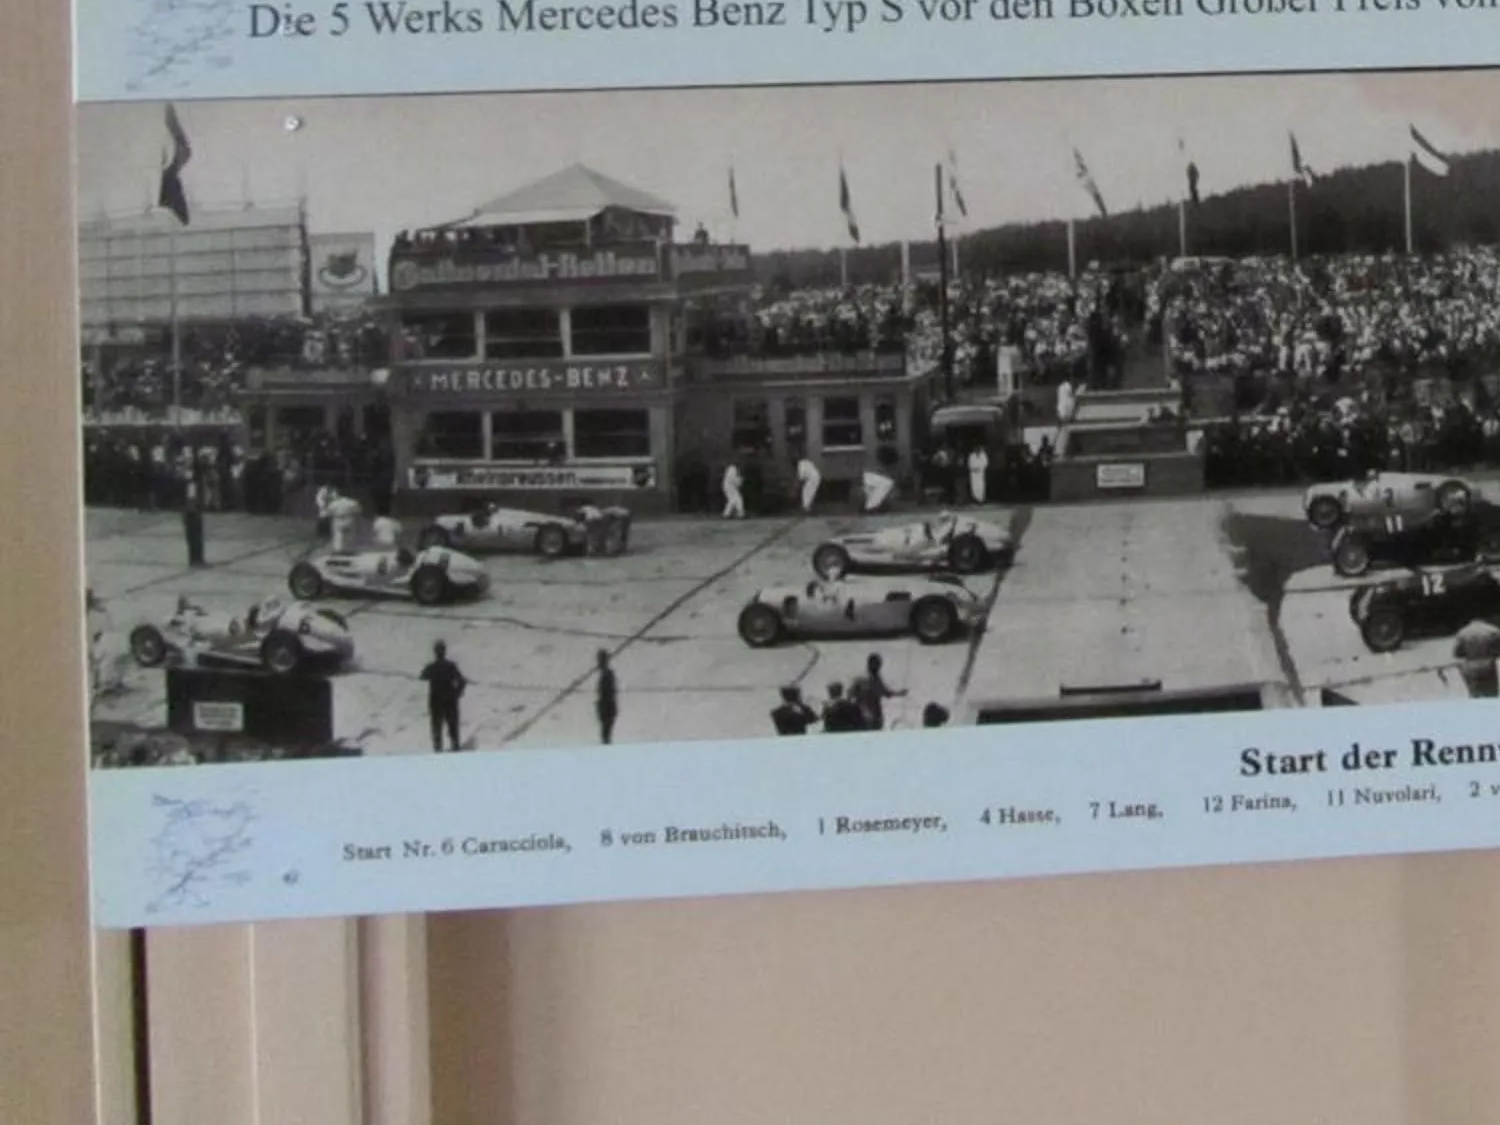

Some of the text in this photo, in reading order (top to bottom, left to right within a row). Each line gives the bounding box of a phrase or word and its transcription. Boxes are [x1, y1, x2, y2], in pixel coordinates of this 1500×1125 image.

[248, 2, 317, 38] Die
[329, 1, 350, 37] 5
[430, 365, 631, 392] MERCEDES-BENZ
[1420, 573, 1447, 597] 12
[1239, 747, 1328, 778] Start
[1340, 741, 1399, 772] der
[342, 842, 393, 862] Start
[402, 839, 437, 859] Nr.
[439, 837, 455, 856] 6
[619, 830, 657, 847] von
[834, 815, 949, 836] Rosemeyer,
[978, 807, 992, 826] 4
[997, 805, 1062, 826] Hasse,
[1088, 800, 1101, 821] 7
[1203, 794, 1225, 814] 12
[1230, 792, 1298, 813] Farina,
[1352, 781, 1442, 806] Nuvolari,
[1468, 779, 1481, 799] 2
